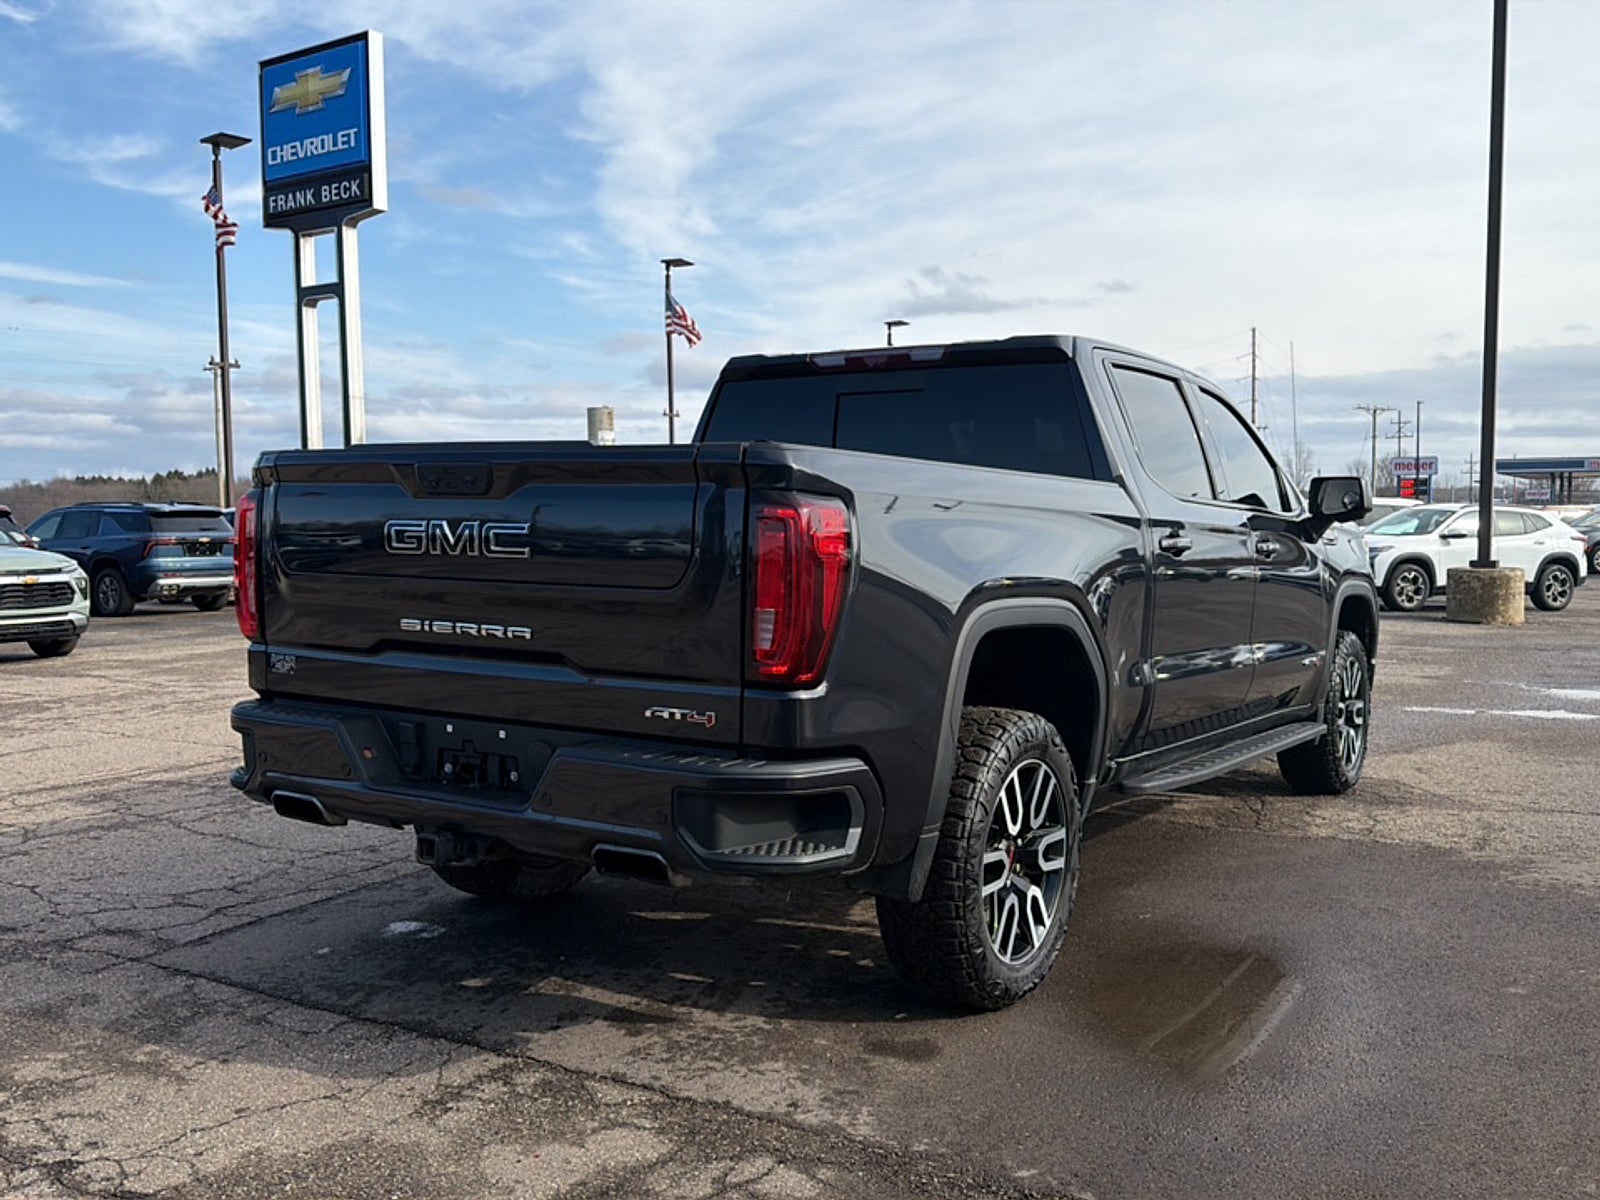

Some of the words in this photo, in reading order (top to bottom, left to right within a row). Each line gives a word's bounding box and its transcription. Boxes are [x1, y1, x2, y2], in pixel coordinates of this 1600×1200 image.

[267, 128, 358, 165] CHEVROLET
[269, 188, 315, 213] FRANK
[321, 180, 360, 203] BECK
[384, 519, 531, 558] GMC
[400, 618, 532, 640] SIERRA
[644, 706, 717, 728] AT4
